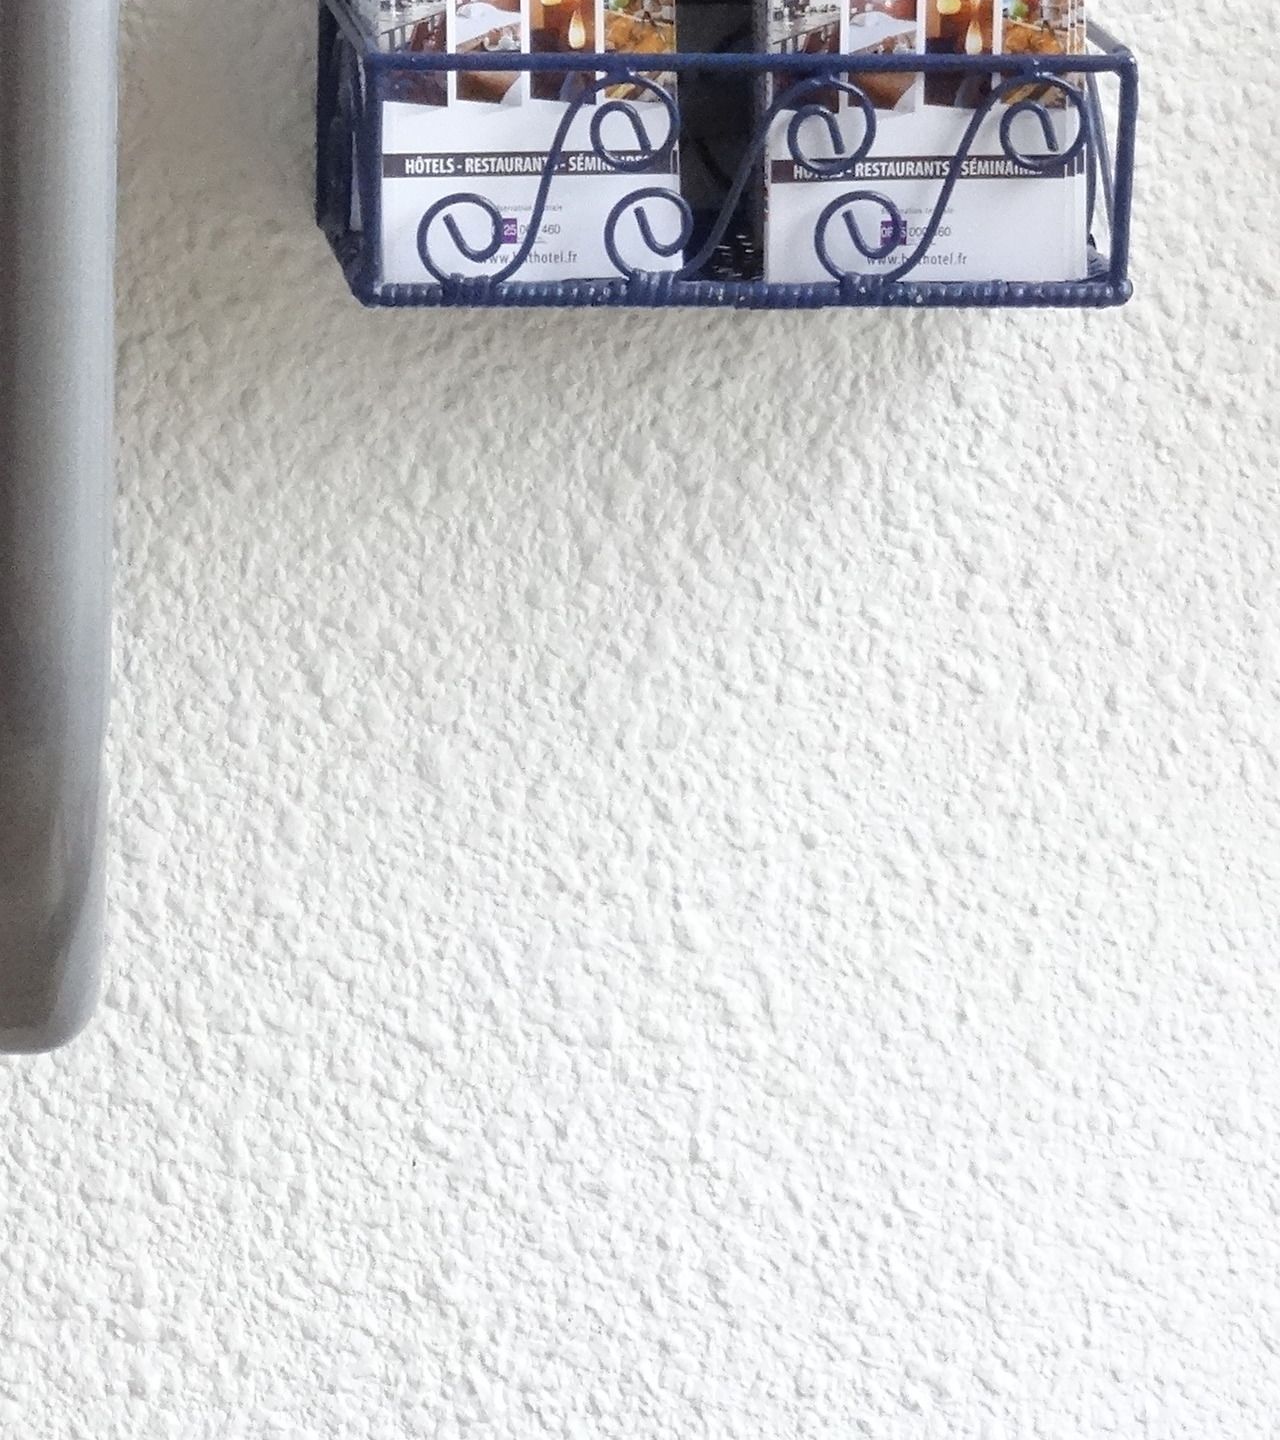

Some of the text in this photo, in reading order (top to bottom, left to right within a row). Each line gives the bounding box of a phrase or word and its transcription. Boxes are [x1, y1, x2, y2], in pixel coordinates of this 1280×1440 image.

[404, 155, 455, 175] HÔTELS
[464, 155, 558, 174] RESTAURANT
[854, 159, 950, 178] RESTAURANTS
